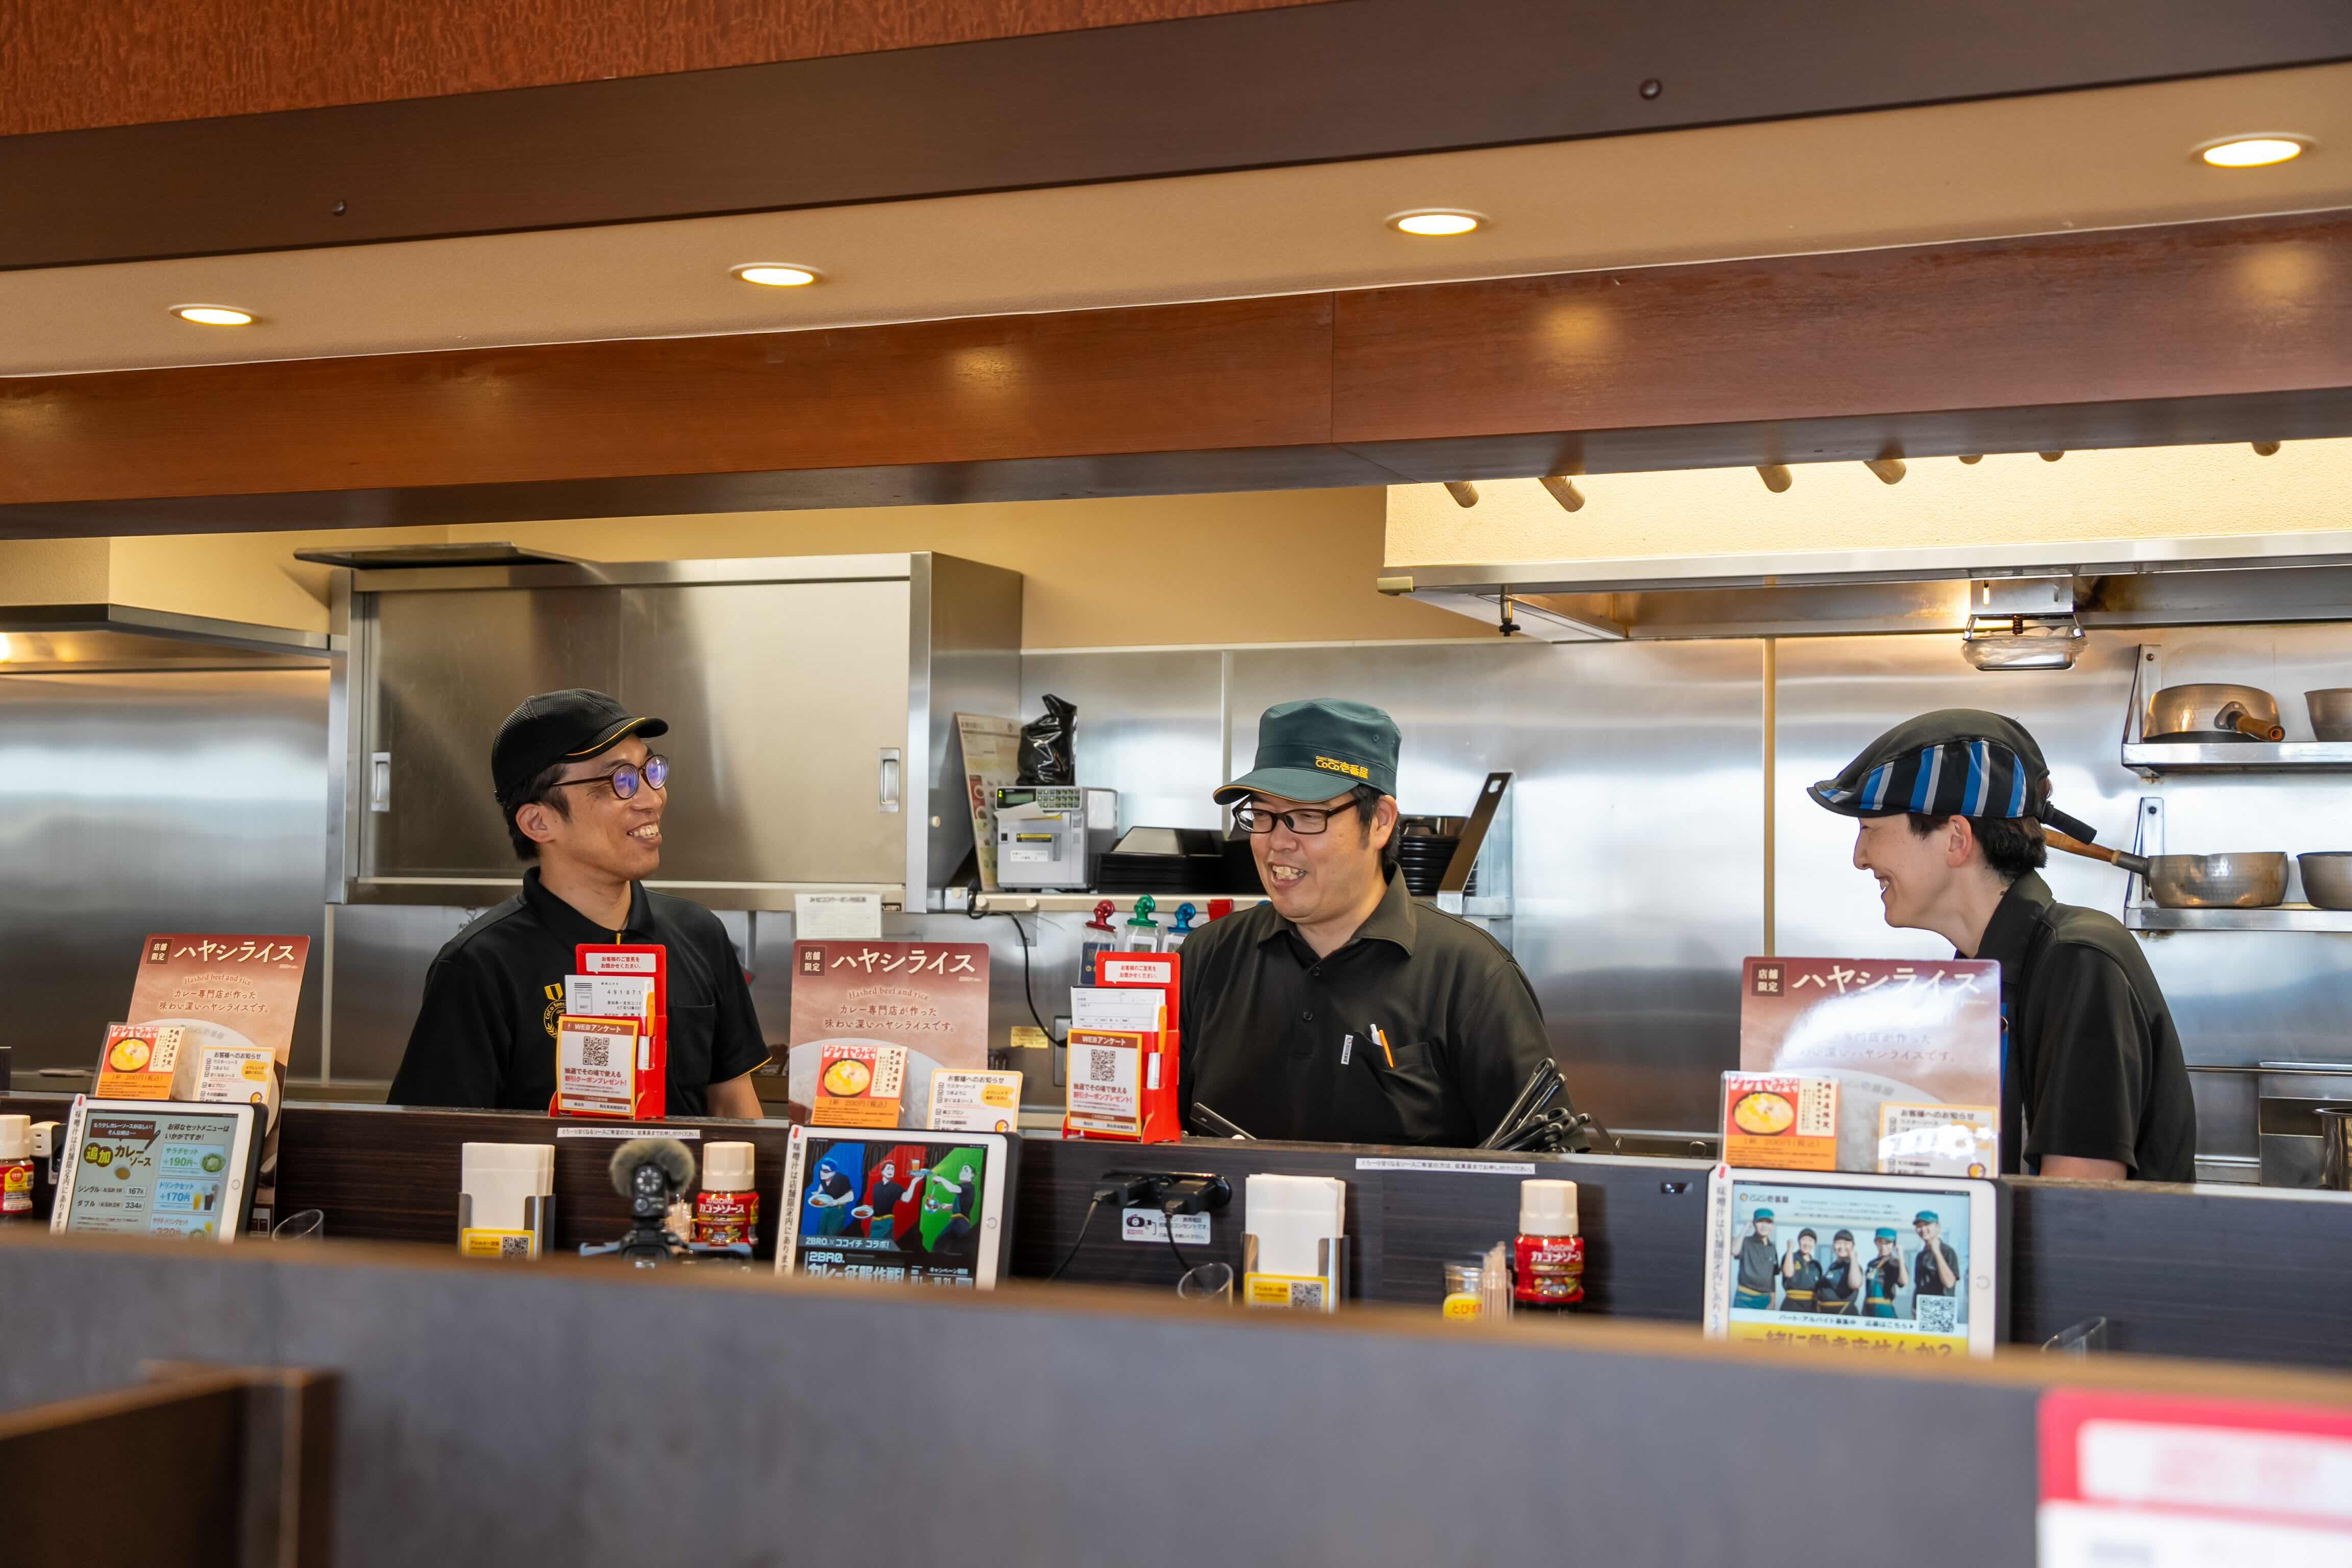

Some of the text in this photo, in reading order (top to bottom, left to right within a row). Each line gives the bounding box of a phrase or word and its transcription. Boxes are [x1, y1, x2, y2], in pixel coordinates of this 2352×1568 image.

[1315, 760, 1368, 779] CoCo壱番屋
[153, 942, 168, 951] 店舗
[174, 940, 295, 963] ハヤシライス
[151, 952, 165, 961] 限定
[804, 951, 821, 961] 店舗
[831, 948, 975, 974] ハヤシライス
[804, 962, 821, 972] 限定
[184, 973, 209, 985] Hashed
[238, 977, 252, 986] rice
[1757, 968, 1779, 980] 店舗
[1792, 965, 1981, 994] ハヤシライス
[1757, 981, 1779, 993] 限定
[174, 989, 256, 999] カレー専門店が作った
[849, 987, 929, 1001] Hashed beef and rice
[159, 1001, 269, 1013] 味わい深いハヤシライスです。
[839, 1004, 938, 1017] カレー専門店が作った
[574, 1023, 622, 1034] WEBアンケート
[824, 1019, 955, 1032] 味わい深いハヤシライスです。
[1082, 1035, 1126, 1046] WEBアンケート
[214, 1051, 261, 1060] お客様へのお知らせ
[823, 1045, 876, 1060] タケヤみそ
[564, 1067, 622, 1078] 抽選でその場で使える
[564, 1075, 627, 1086] 割引クーポンプレゼント!
[947, 1075, 1004, 1084] お客様へのお知らせ
[1073, 1083, 1128, 1094] 抽選でその場で使える
[1073, 1091, 1133, 1104] 割引クーポンプレゼント!
[1901, 1109, 1974, 1120] お客様へのお知らせ
[167, 1123, 230, 1132] お得なセットメニューは
[86, 1146, 112, 1164] 追加
[114, 1144, 144, 1158] カレー
[165, 1147, 199, 1155] サラダセット
[130, 1157, 152, 1167] ソース
[78, 1185, 100, 1193] シングル
[159, 1181, 194, 1190] ドリンクセット
[159, 1192, 191, 1202] +170円
[699, 1204, 745, 1214] カゴメソース
[866, 1240, 890, 1249] コラボ!
[1531, 1251, 1582, 1263] カゴメソース
[1779, 1313, 1909, 1330] パート・アルバイト募集中 応募はこちら
